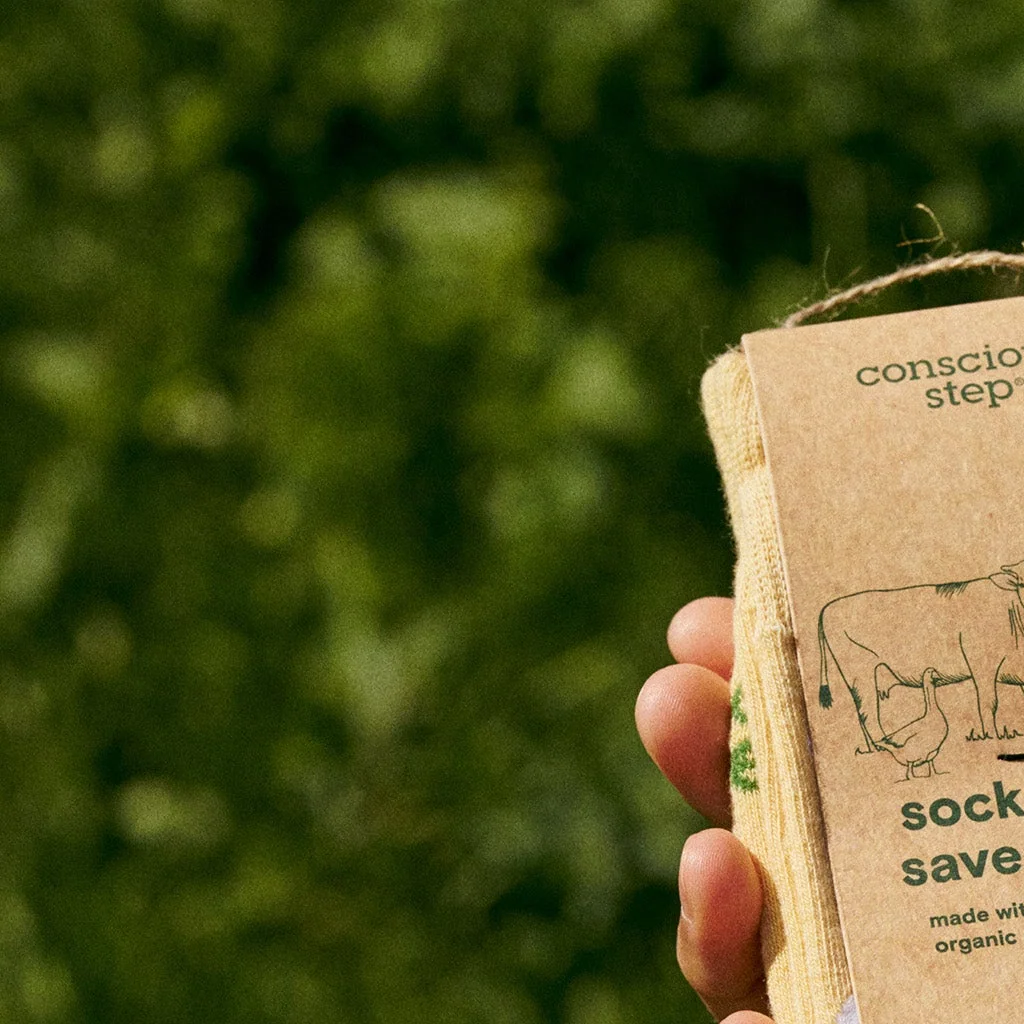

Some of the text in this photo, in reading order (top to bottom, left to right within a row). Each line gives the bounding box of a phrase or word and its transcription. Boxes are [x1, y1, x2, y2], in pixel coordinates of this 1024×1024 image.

[901, 846, 1022, 886] save
[929, 907, 989, 928] made
[935, 931, 1017, 954] organic
